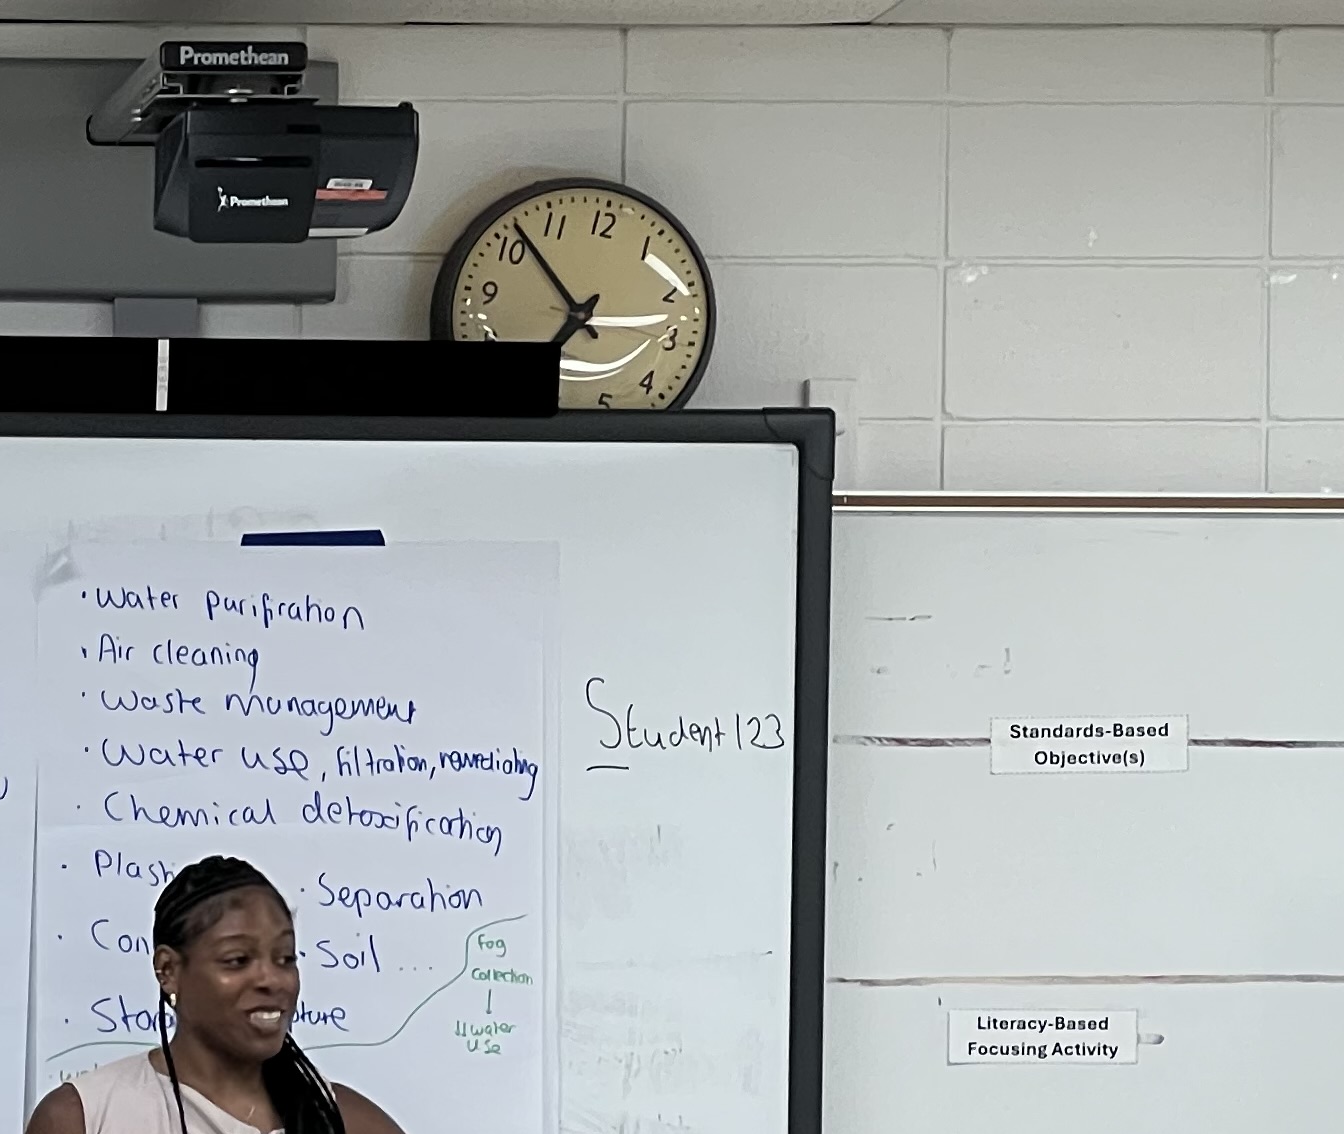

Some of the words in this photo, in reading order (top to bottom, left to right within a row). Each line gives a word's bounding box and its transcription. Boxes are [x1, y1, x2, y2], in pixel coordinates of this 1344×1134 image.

[180, 46, 289, 66] Promethean
[544, 212, 566, 240] 11
[591, 210, 616, 239] 12
[499, 236, 525, 265] 10
[641, 236, 650, 261] 1
[482, 281, 498, 305] 9
[639, 370, 655, 394] 4
[205, 589, 365, 630] purification
[98, 633, 135, 664] Air
[152, 639, 259, 692] cleaning
[224, 692, 417, 736] management
[1010, 723, 1169, 739] Standards-Based
[1034, 750, 1145, 768] Objective(s)
[104, 791, 277, 828] Chemical
[302, 791, 502, 857] detoxification
[318, 872, 483, 914] Separation
[314, 940, 382, 973] Soil
[977, 1016, 1109, 1033] Literacy-Based
[968, 1041, 1047, 1059] Focusing
[1051, 1042, 1119, 1059] Activity
